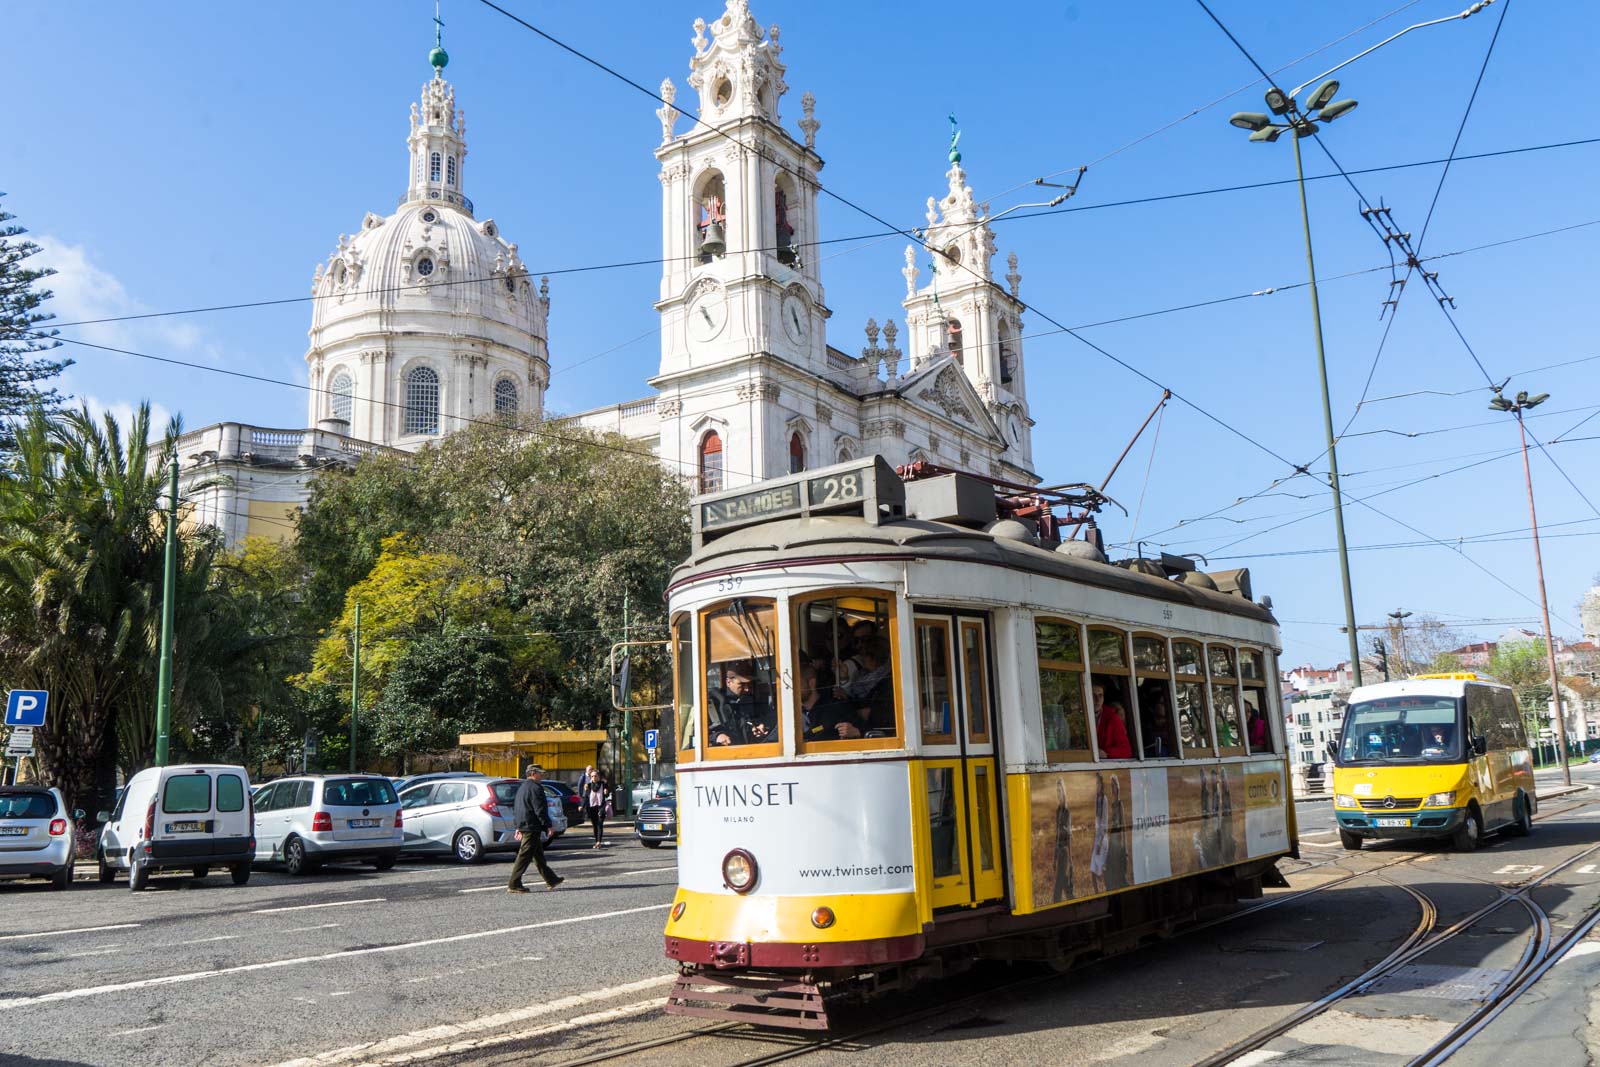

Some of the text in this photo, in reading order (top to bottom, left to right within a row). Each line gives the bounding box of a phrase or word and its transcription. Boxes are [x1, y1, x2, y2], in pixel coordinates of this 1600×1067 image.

[823, 474, 858, 506] 28
[718, 576, 743, 592] 559
[15, 695, 38, 720] P
[647, 733, 654, 746] P
[694, 782, 799, 808] TWINSET
[799, 863, 914, 878] www.twinset.com
